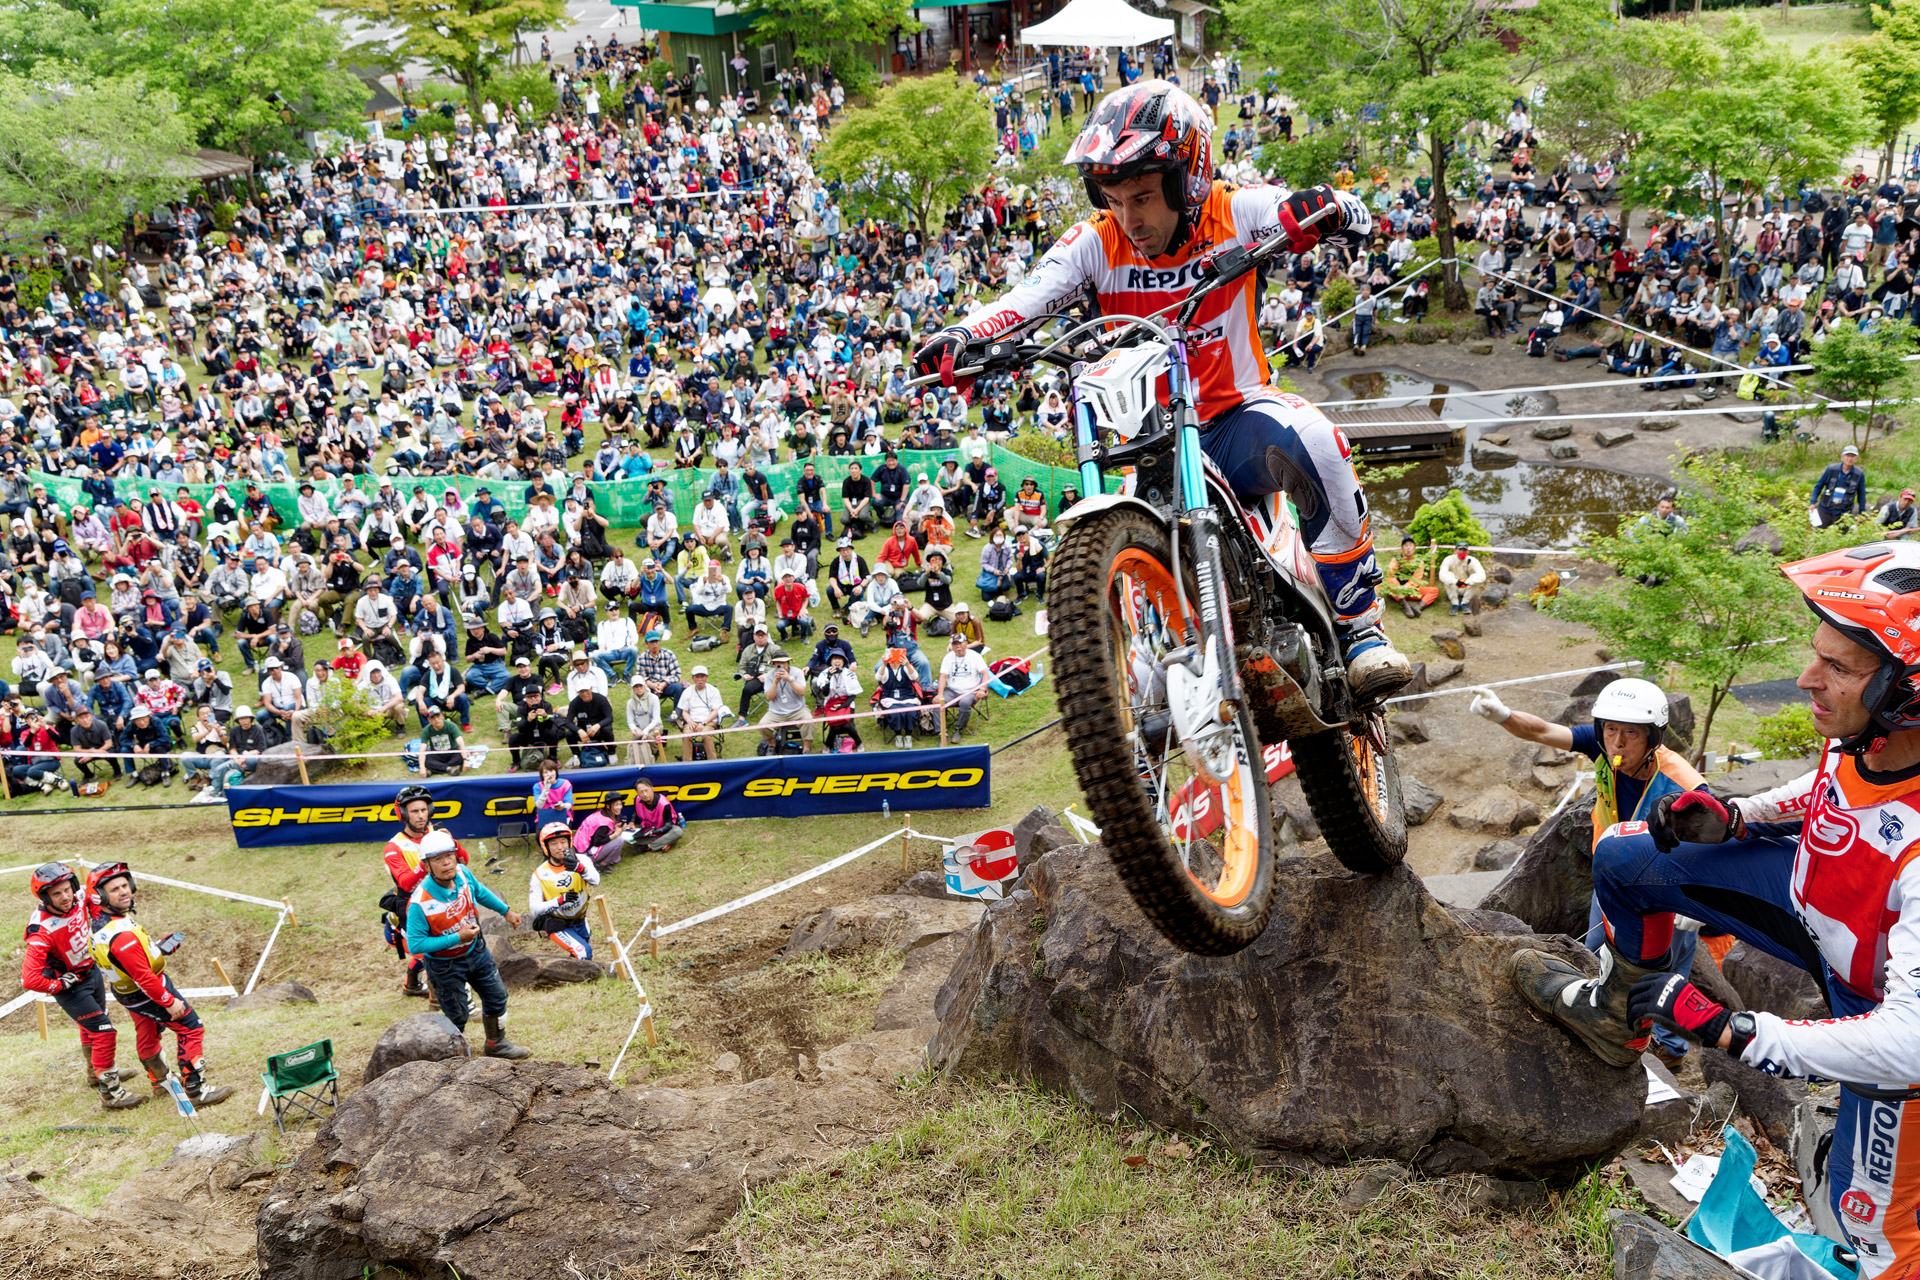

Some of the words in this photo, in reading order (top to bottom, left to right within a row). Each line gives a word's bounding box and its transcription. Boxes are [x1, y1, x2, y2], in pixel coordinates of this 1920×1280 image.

[1128, 260, 1205, 289] REPSO
[969, 309, 1027, 339] HONDA
[1817, 589, 1866, 600] hebo
[484, 782, 723, 816] SERCO
[743, 768, 985, 797] SHERCO
